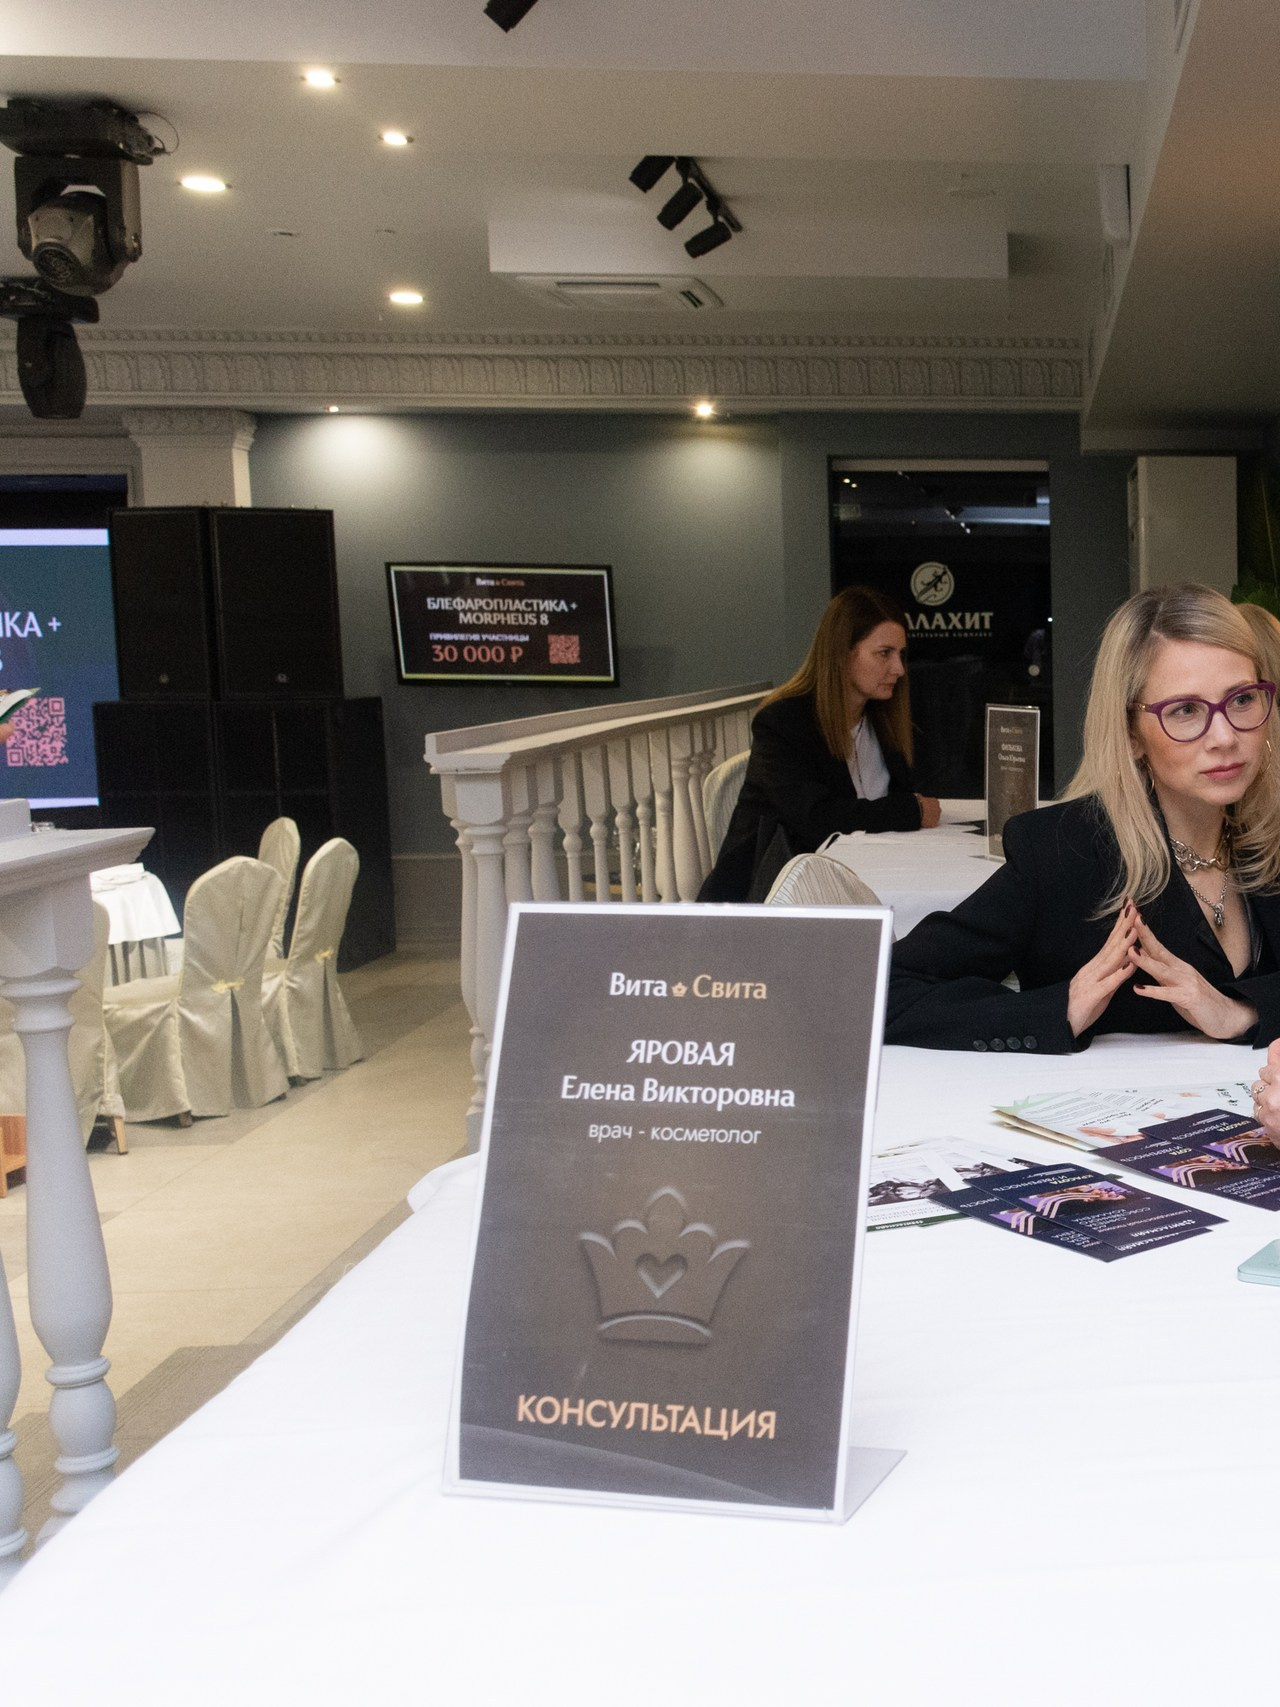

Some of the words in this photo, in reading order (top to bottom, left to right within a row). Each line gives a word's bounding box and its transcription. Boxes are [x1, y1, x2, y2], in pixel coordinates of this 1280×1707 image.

[426, 597, 568, 612] БЛЕФАРОПЛАСТИКА
[0, 611, 44, 638] КА
[459, 612, 538, 626] MORPHEUS
[540, 613, 549, 626] 8
[904, 612, 994, 630] ЛАХИТ
[432, 645, 458, 662] 30
[463, 645, 505, 663] 000
[609, 972, 668, 997] Вита
[692, 974, 767, 999] Свита
[626, 1039, 736, 1067] ЯРОВАЯ
[560, 1075, 636, 1102] Елена
[642, 1077, 796, 1112] Викторовна
[588, 1124, 633, 1143] врач
[650, 1126, 762, 1145] косметолог
[516, 1394, 778, 1440] КОНСУЛЬТАЦИЯ
